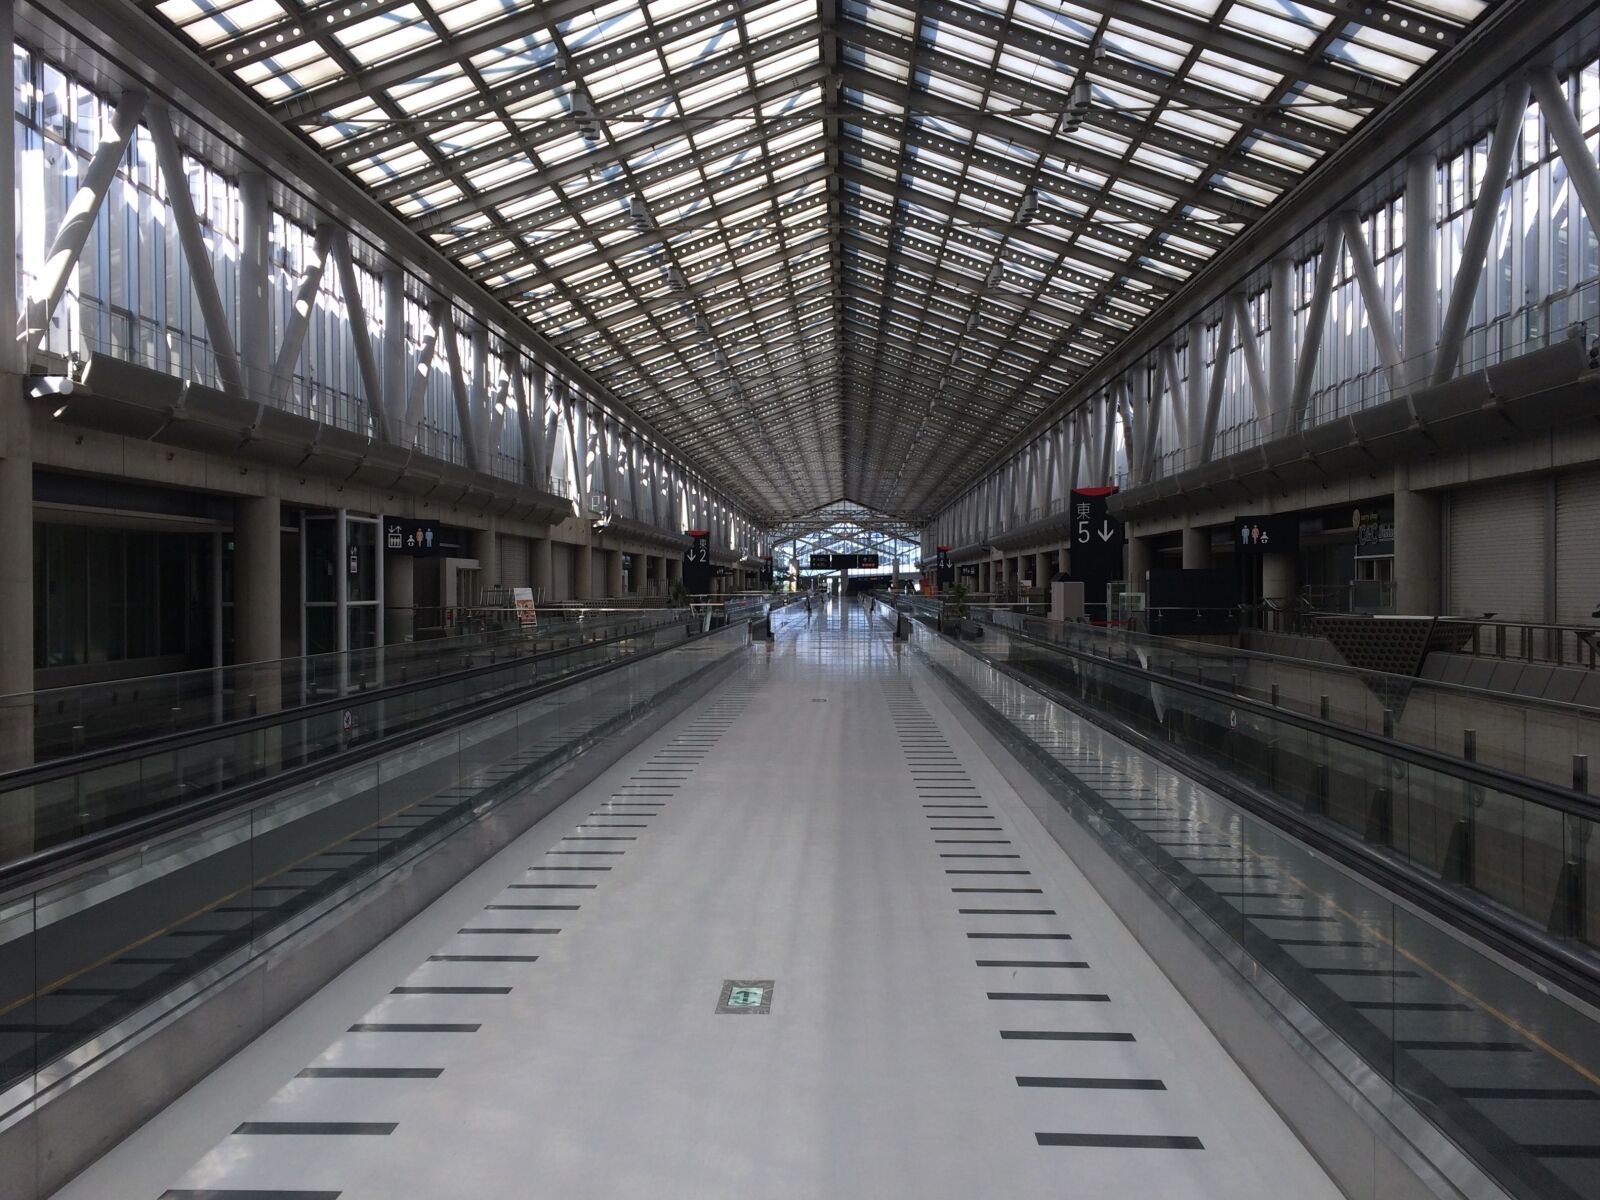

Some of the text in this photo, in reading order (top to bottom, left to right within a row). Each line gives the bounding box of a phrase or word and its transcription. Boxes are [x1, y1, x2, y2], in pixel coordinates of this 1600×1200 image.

[1076, 501, 1092, 520] 東
[1078, 521, 1090, 543] 5
[699, 549, 707, 563] 2
[938, 560, 944, 569] 4
